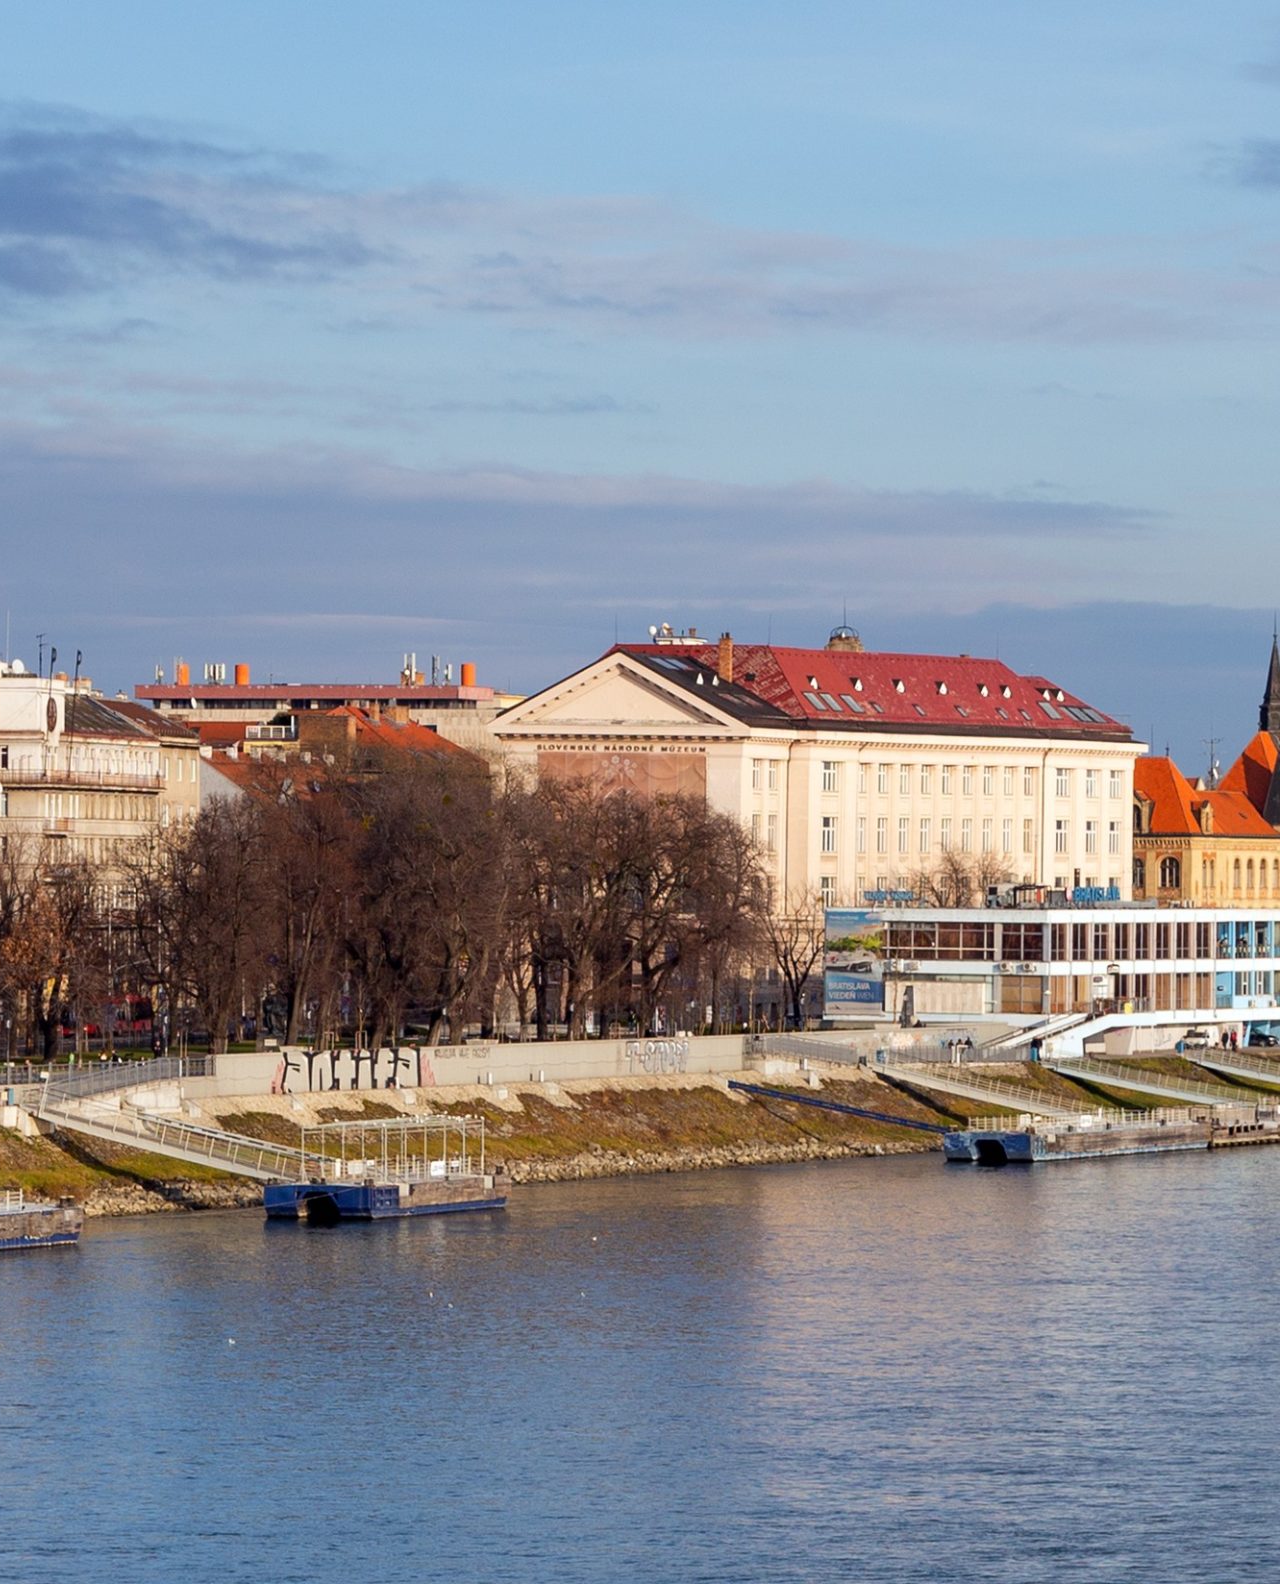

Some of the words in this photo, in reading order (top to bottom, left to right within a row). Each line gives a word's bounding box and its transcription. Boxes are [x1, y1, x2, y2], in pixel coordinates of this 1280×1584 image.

[604, 743, 654, 752] NÁRODNÉ
[660, 744, 706, 753] MÚZEUM
[1074, 886, 1120, 902] BRATISLAVA
[828, 981, 871, 990] BRATISLAVA
